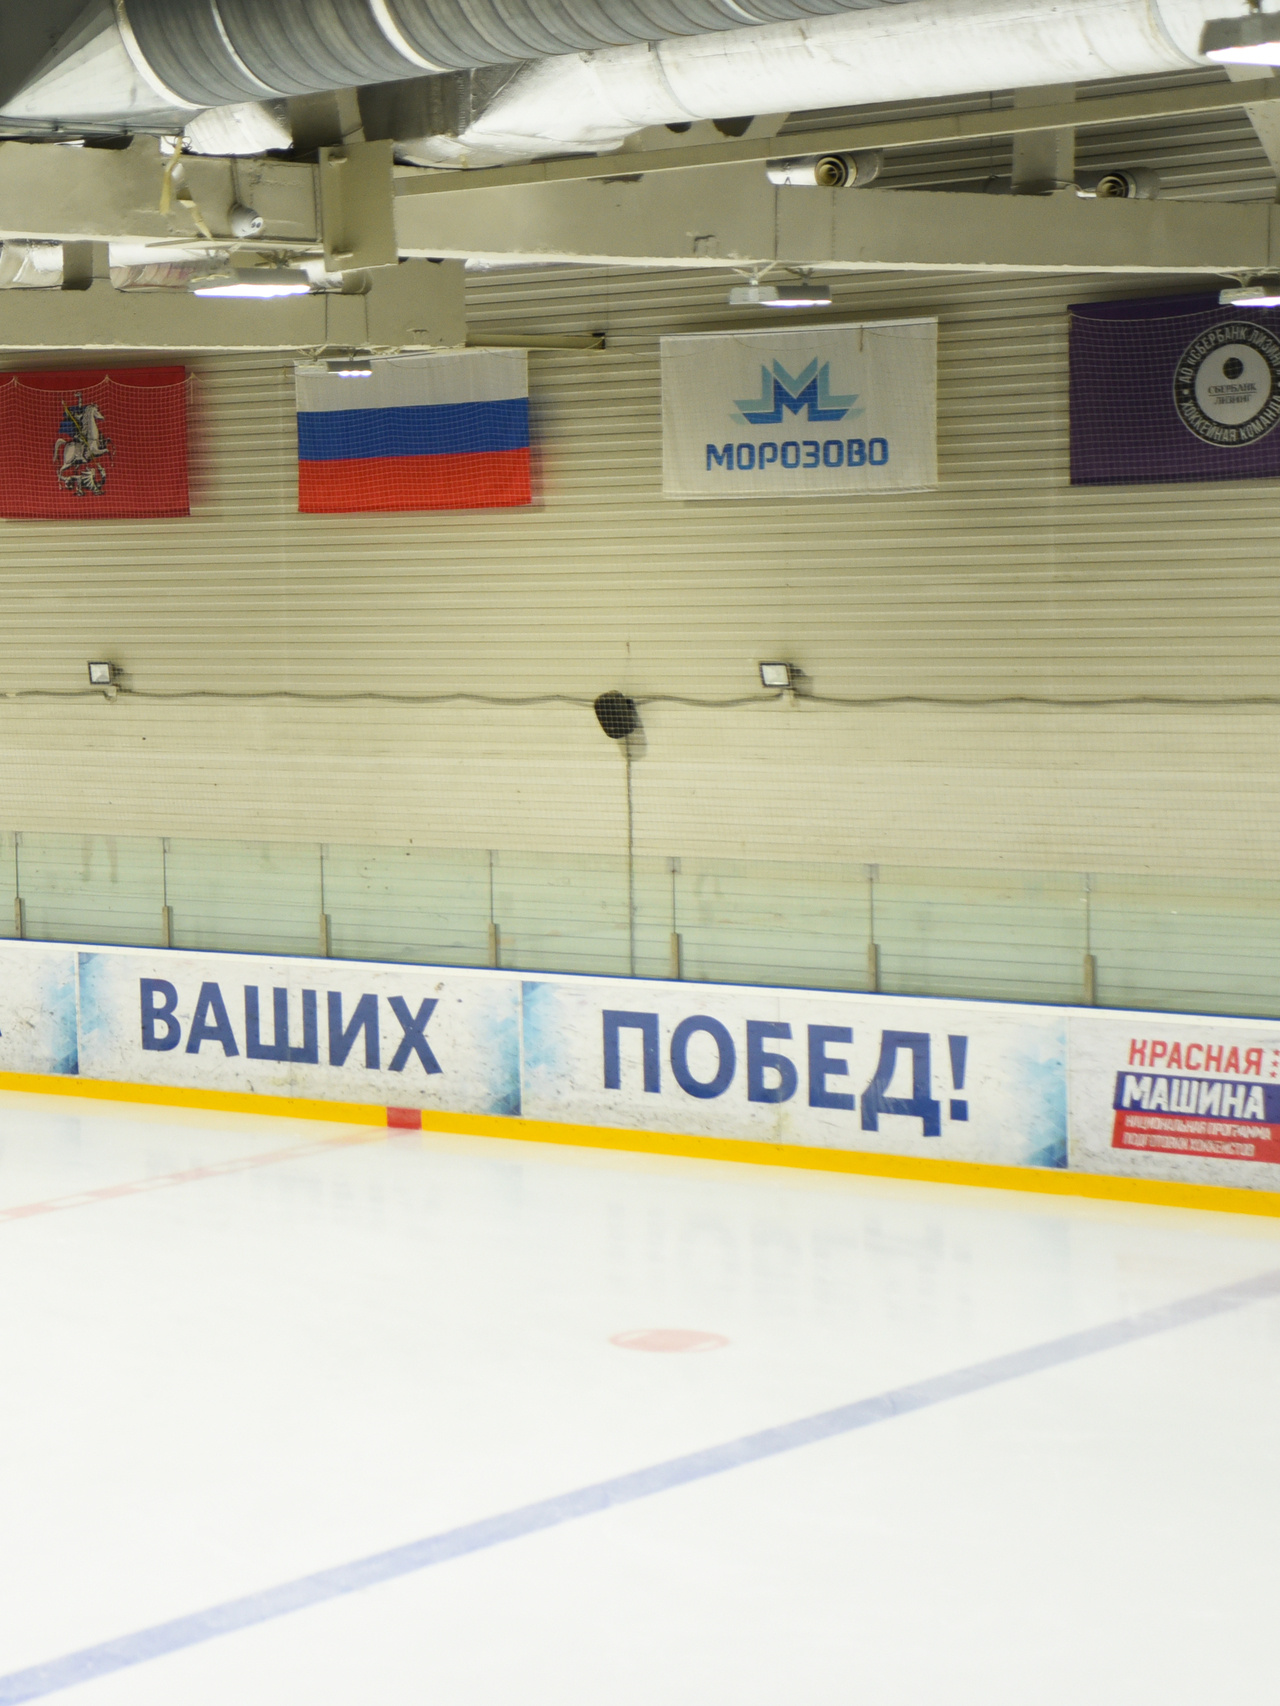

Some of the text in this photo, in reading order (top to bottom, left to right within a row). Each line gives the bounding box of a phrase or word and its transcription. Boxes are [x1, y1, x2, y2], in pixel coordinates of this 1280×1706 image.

[1179, 367, 1193, 383] АО
[706, 437, 889, 471] МОРОЗОВО
[139, 977, 444, 1076] ВАШИХ
[602, 1009, 969, 1138] ПОБЕД!
[1128, 1038, 1264, 1076] КРАСНАЯ
[1121, 1074, 1266, 1121] МАШИНА
